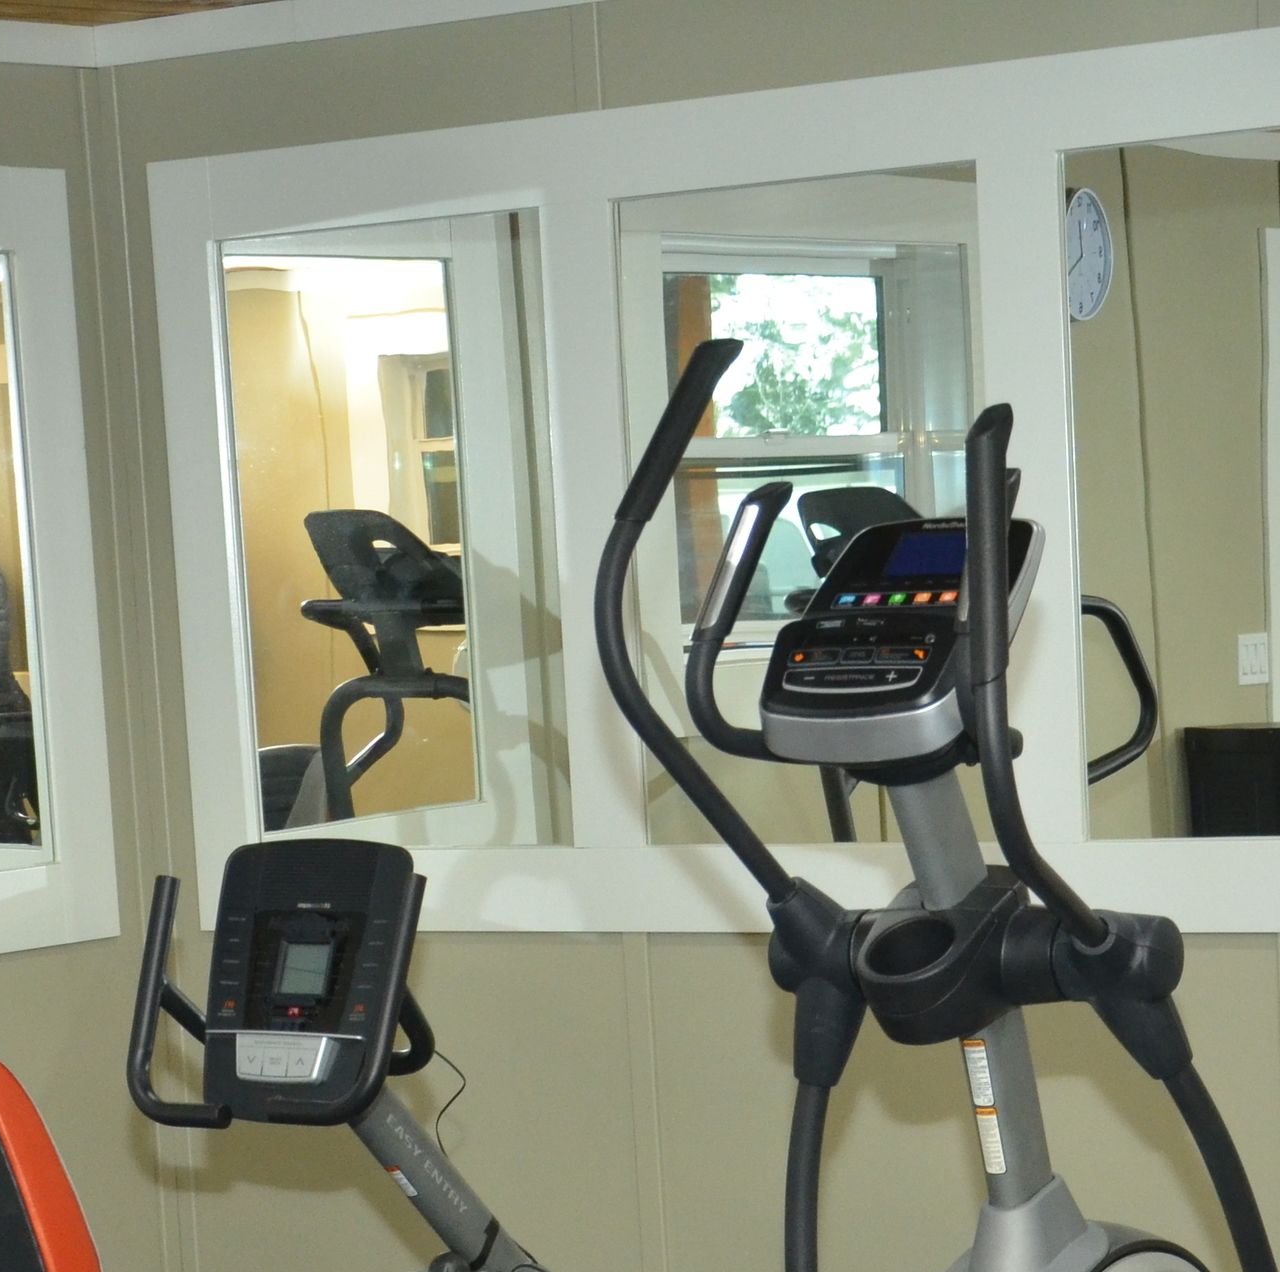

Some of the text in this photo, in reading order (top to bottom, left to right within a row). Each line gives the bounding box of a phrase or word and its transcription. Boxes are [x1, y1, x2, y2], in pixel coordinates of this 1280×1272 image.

[922, 521, 966, 530] NordicTra
[385, 1113, 423, 1157] EASY
[423, 1159, 468, 1213] ENTRY
